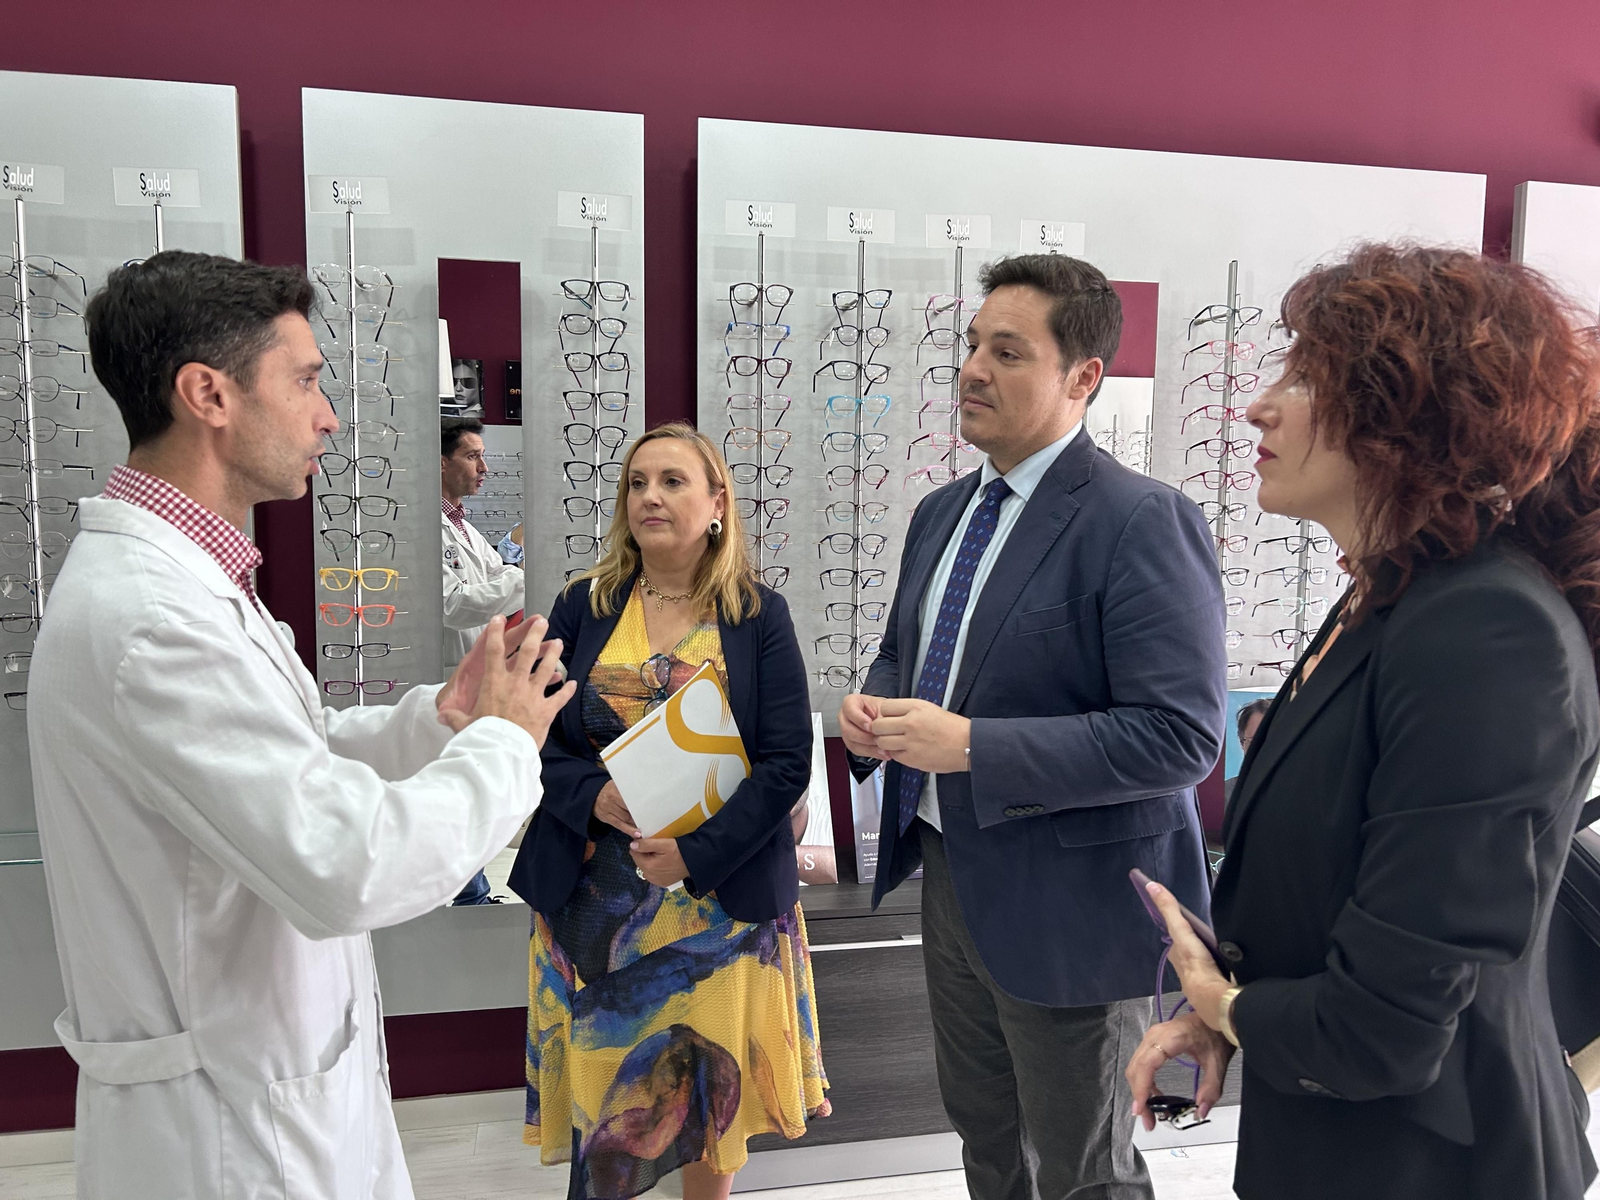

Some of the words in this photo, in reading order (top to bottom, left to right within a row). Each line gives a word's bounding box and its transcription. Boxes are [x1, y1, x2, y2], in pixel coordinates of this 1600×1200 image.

[3, 165, 34, 187] Salud
[140, 172, 171, 192] Salud
[3, 183, 34, 193] Visión
[333, 180, 362, 200] Salud
[581, 197, 607, 216] Salud
[748, 204, 773, 223] Salud
[581, 214, 607, 222] Visión
[849, 212, 873, 230] Salud
[946, 218, 969, 236] Salud
[1040, 225, 1064, 242] Salud
[1040, 240, 1063, 248] Visión
[798, 853, 815, 870] S
